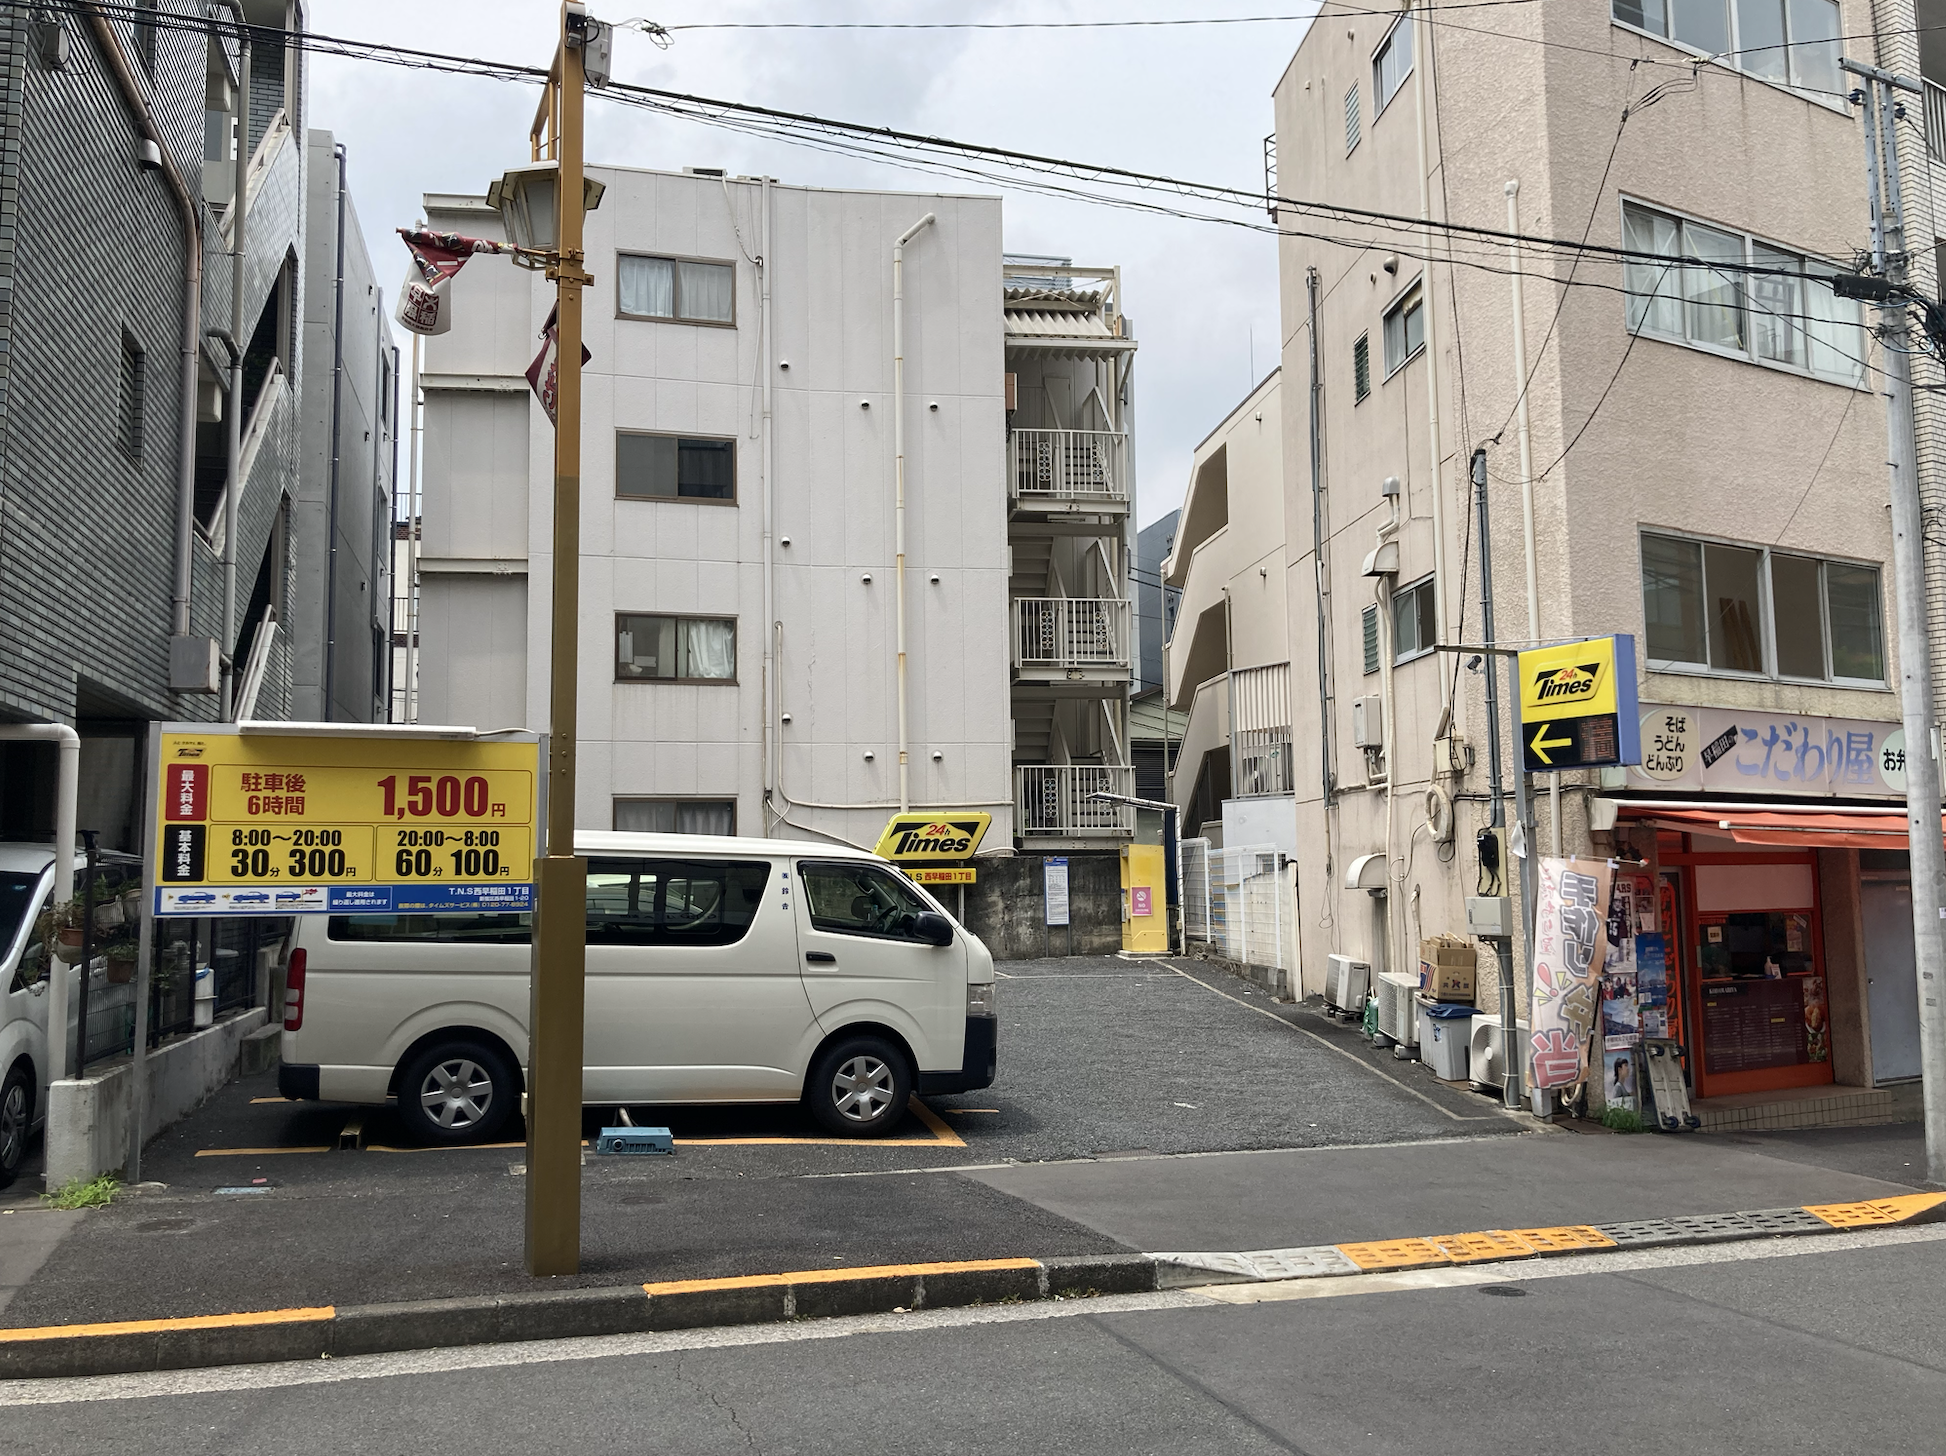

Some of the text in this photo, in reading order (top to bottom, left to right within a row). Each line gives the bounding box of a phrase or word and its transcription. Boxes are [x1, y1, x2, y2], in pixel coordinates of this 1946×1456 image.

[1537, 678, 1593, 700] Times
[1665, 716, 1686, 733] そば
[1654, 734, 1685, 752] うどん
[1735, 721, 1874, 785] こだわり屋
[1646, 754, 1684, 772] どんぶり
[180, 770, 195, 816] 最大料金
[241, 772, 306, 793] 駐車後
[247, 795, 305, 815] 6時間
[377, 775, 506, 821] 1,500円
[926, 824, 951, 836] 24h
[177, 830, 192, 877] 基本料金
[894, 831, 971, 854] Times
[231, 848, 356, 877] 30分 300円
[396, 849, 509, 877] 60分 100円
[924, 871, 972, 881] 西早稲田1丁目
